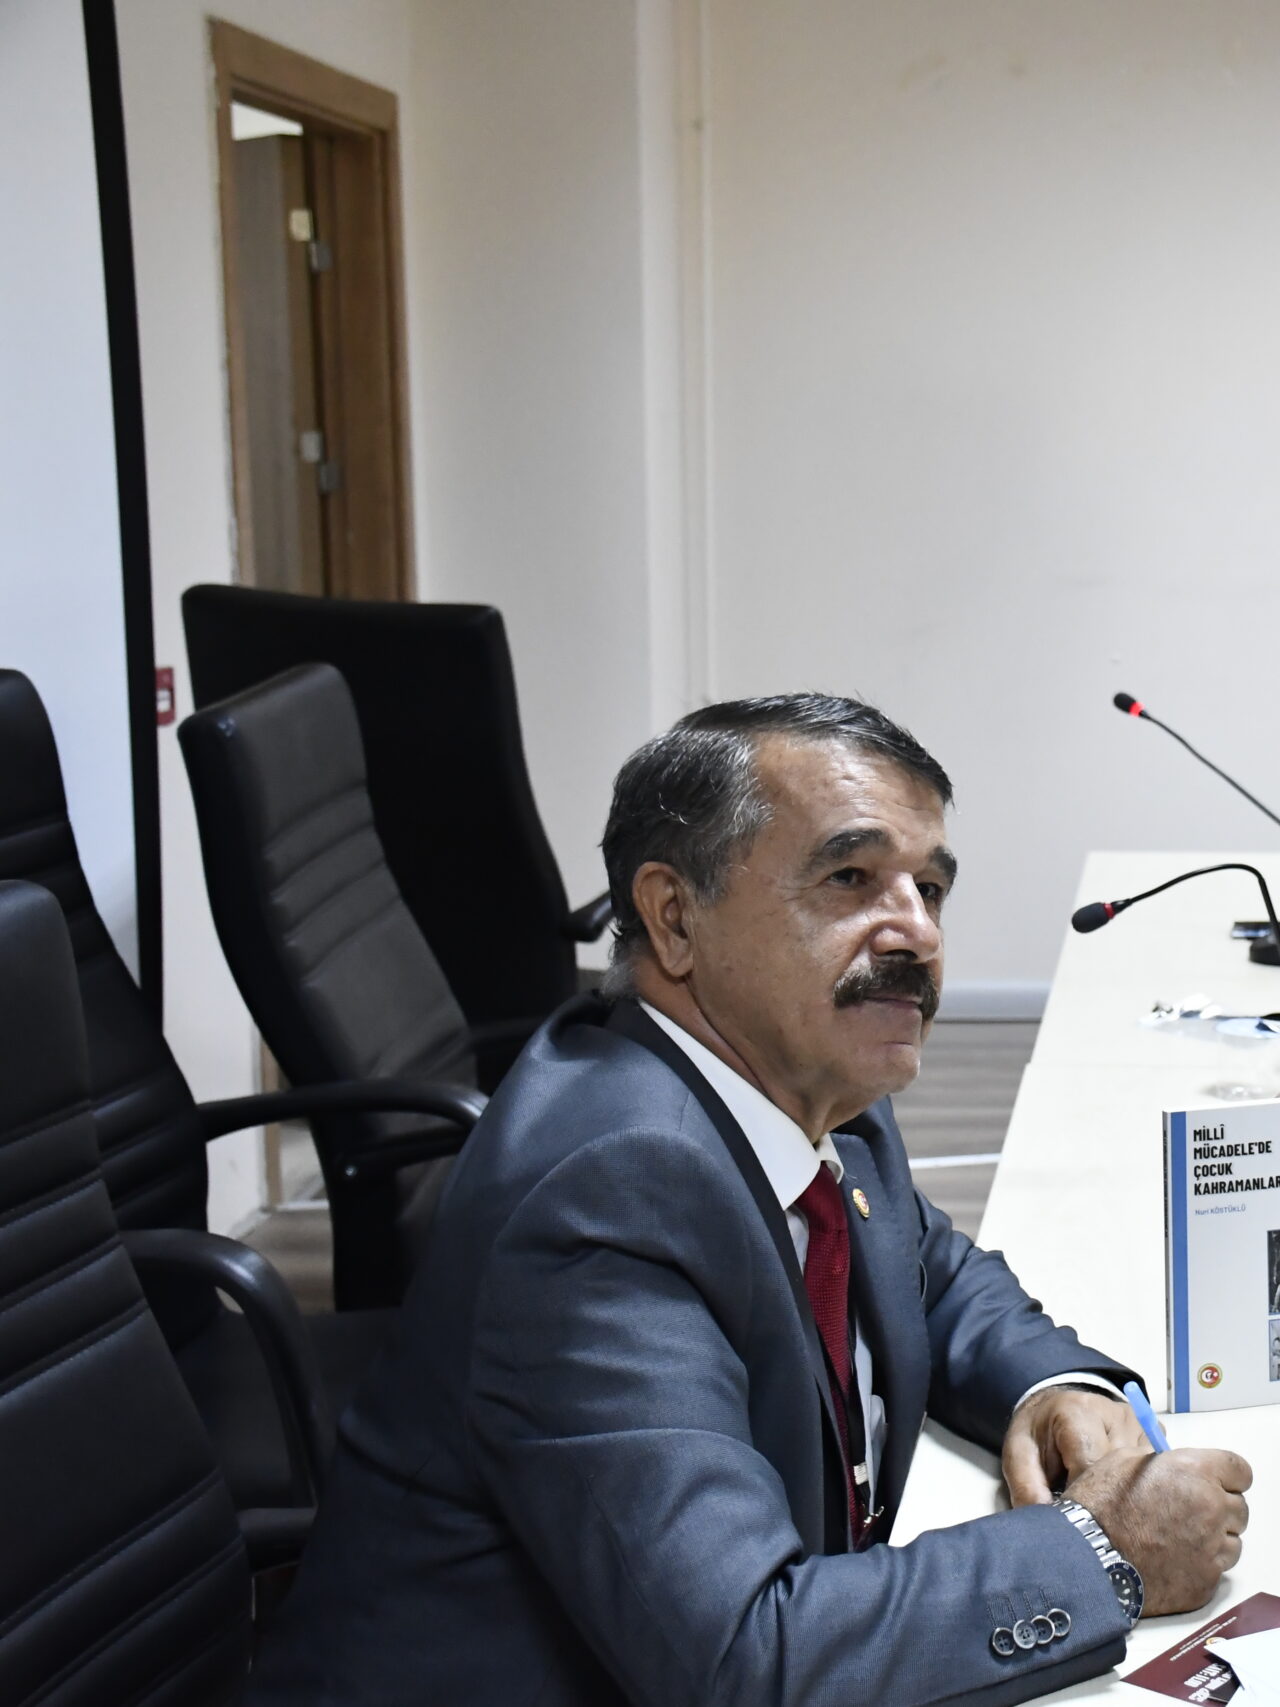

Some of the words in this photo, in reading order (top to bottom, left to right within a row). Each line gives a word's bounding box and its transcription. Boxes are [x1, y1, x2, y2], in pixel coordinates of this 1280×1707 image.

[1193, 1124, 1225, 1142] MİLLÎ
[1193, 1140, 1272, 1160] MÜCADELE'DE
[1194, 1162, 1233, 1181] ÇOCUK
